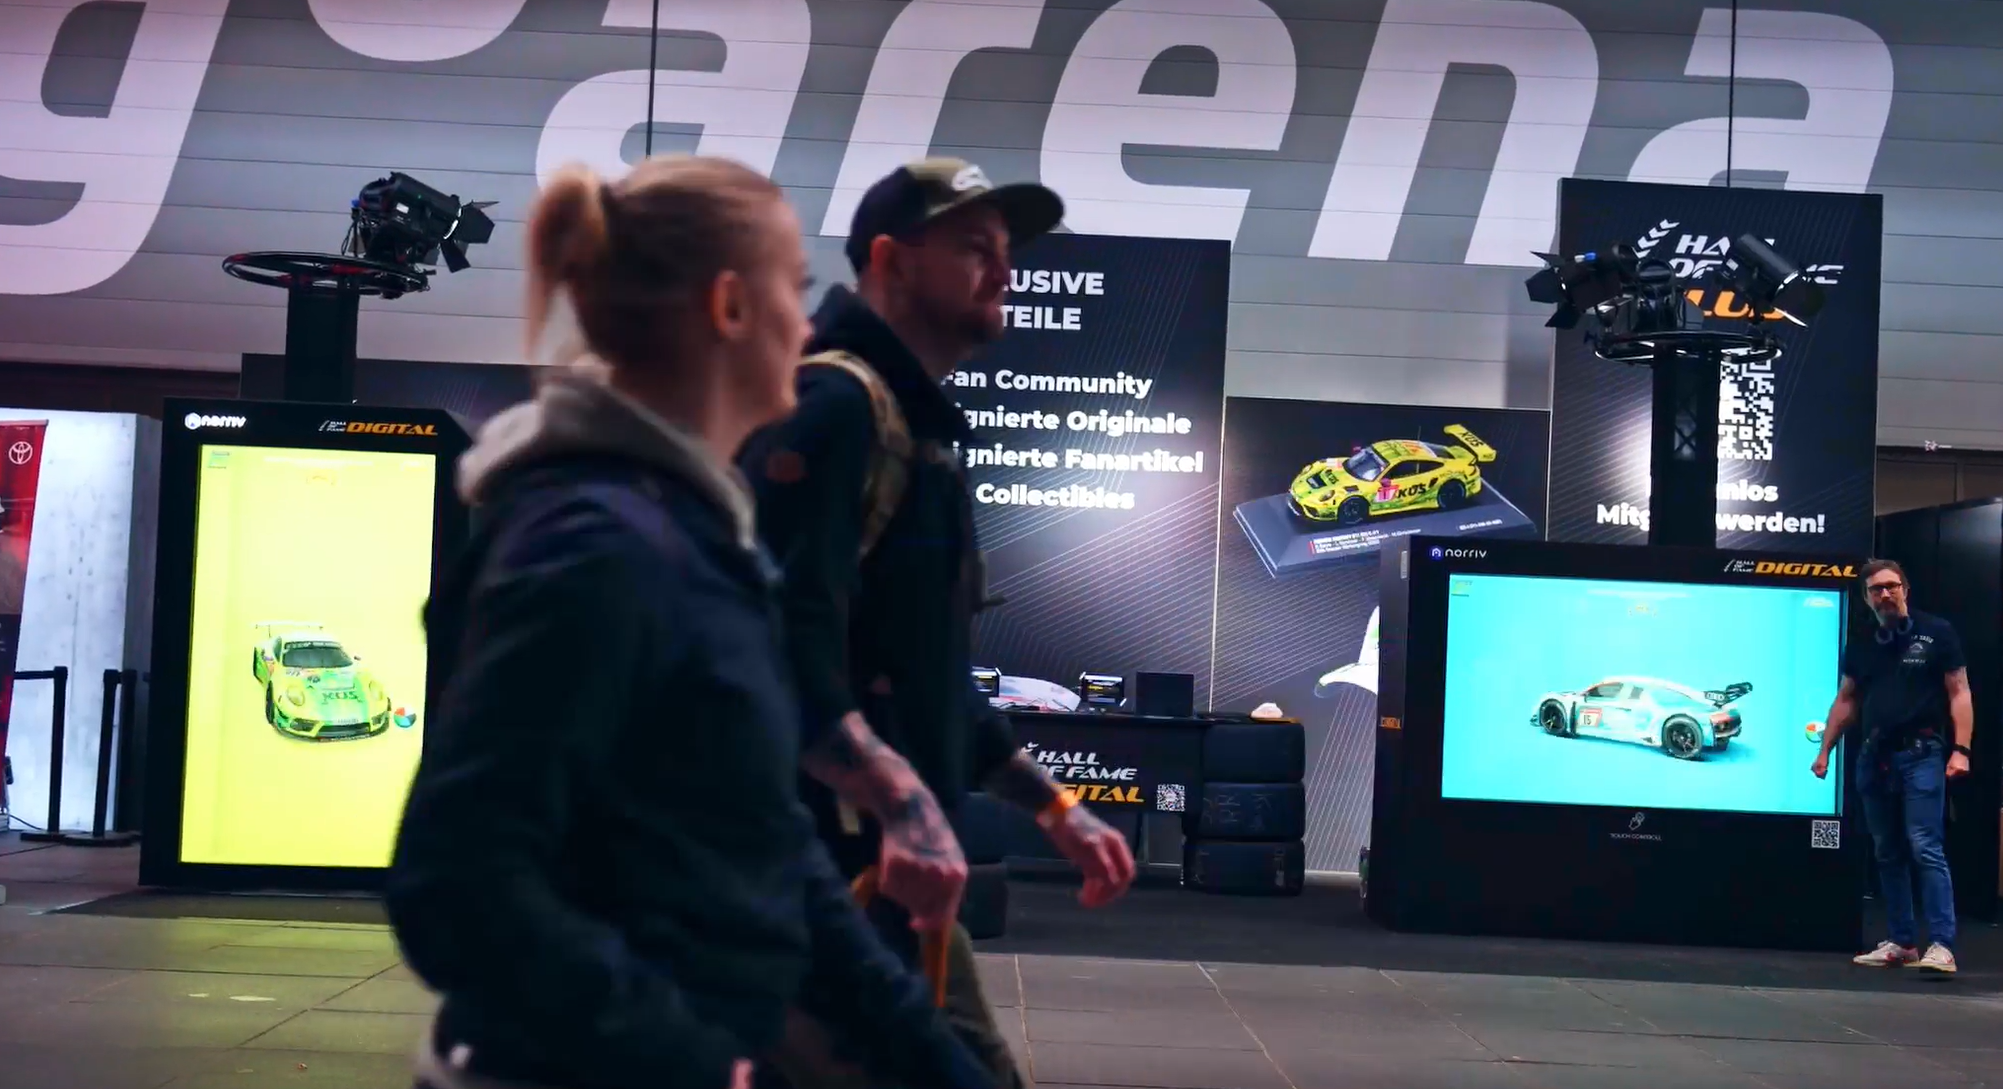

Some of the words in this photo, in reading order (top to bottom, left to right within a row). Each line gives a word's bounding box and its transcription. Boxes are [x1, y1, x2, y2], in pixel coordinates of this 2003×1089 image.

[536, 0, 1894, 266] arena
[1003, 269, 1104, 295] USIVE
[997, 305, 1082, 330] TEILE
[995, 369, 1153, 399] Community
[346, 421, 438, 436] DIGITAL
[954, 402, 1060, 430] gnierte
[1066, 409, 1192, 437] Originale
[1065, 448, 1203, 472] Fanartikel
[975, 482, 1135, 510] Collectibles
[1597, 502, 1650, 532] Mitg
[1716, 511, 1826, 533] werden!
[1444, 548, 1488, 559] norriv
[1755, 561, 1858, 578] DIGITAL
[1037, 750, 1100, 765] HALL
[1065, 767, 1138, 780] FAME
